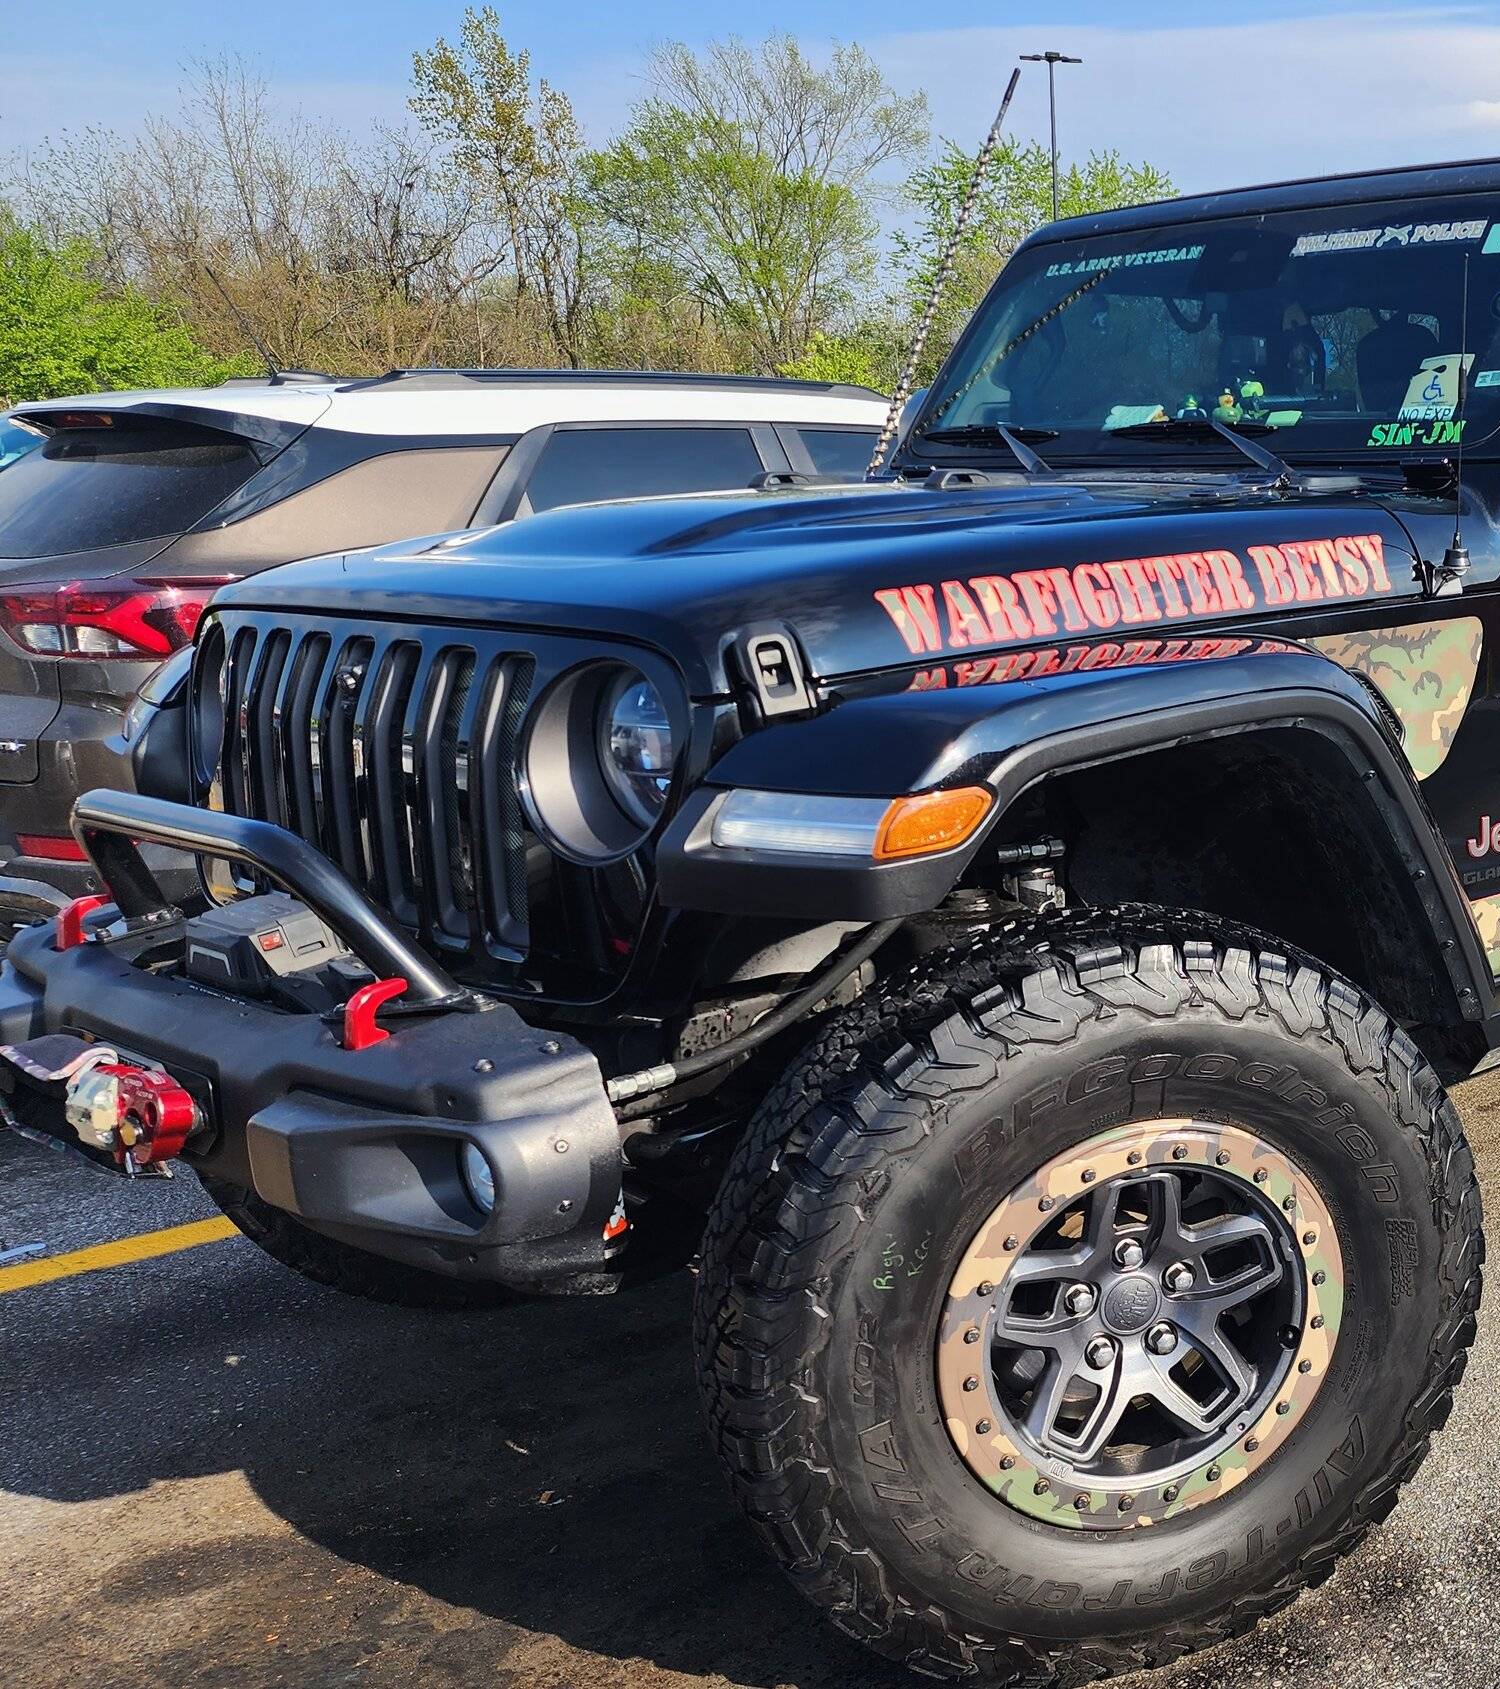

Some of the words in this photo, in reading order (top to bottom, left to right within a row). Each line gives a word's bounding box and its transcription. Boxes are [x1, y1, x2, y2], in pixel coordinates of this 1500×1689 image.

[1044, 262, 1073, 277] U.S.
[1074, 255, 1123, 273] ARMY
[1123, 244, 1206, 267] VETERAN
[1290, 228, 1382, 257] MILITARY
[1410, 219, 1489, 243] POLICE
[1400, 407, 1419, 421] NO
[875, 548, 1255, 654] WARFIGHTER
[1246, 533, 1392, 606] BETSY
[954, 1053, 1399, 1203] BFGoodrich
[955, 1414, 1368, 1612] All-Terrain
